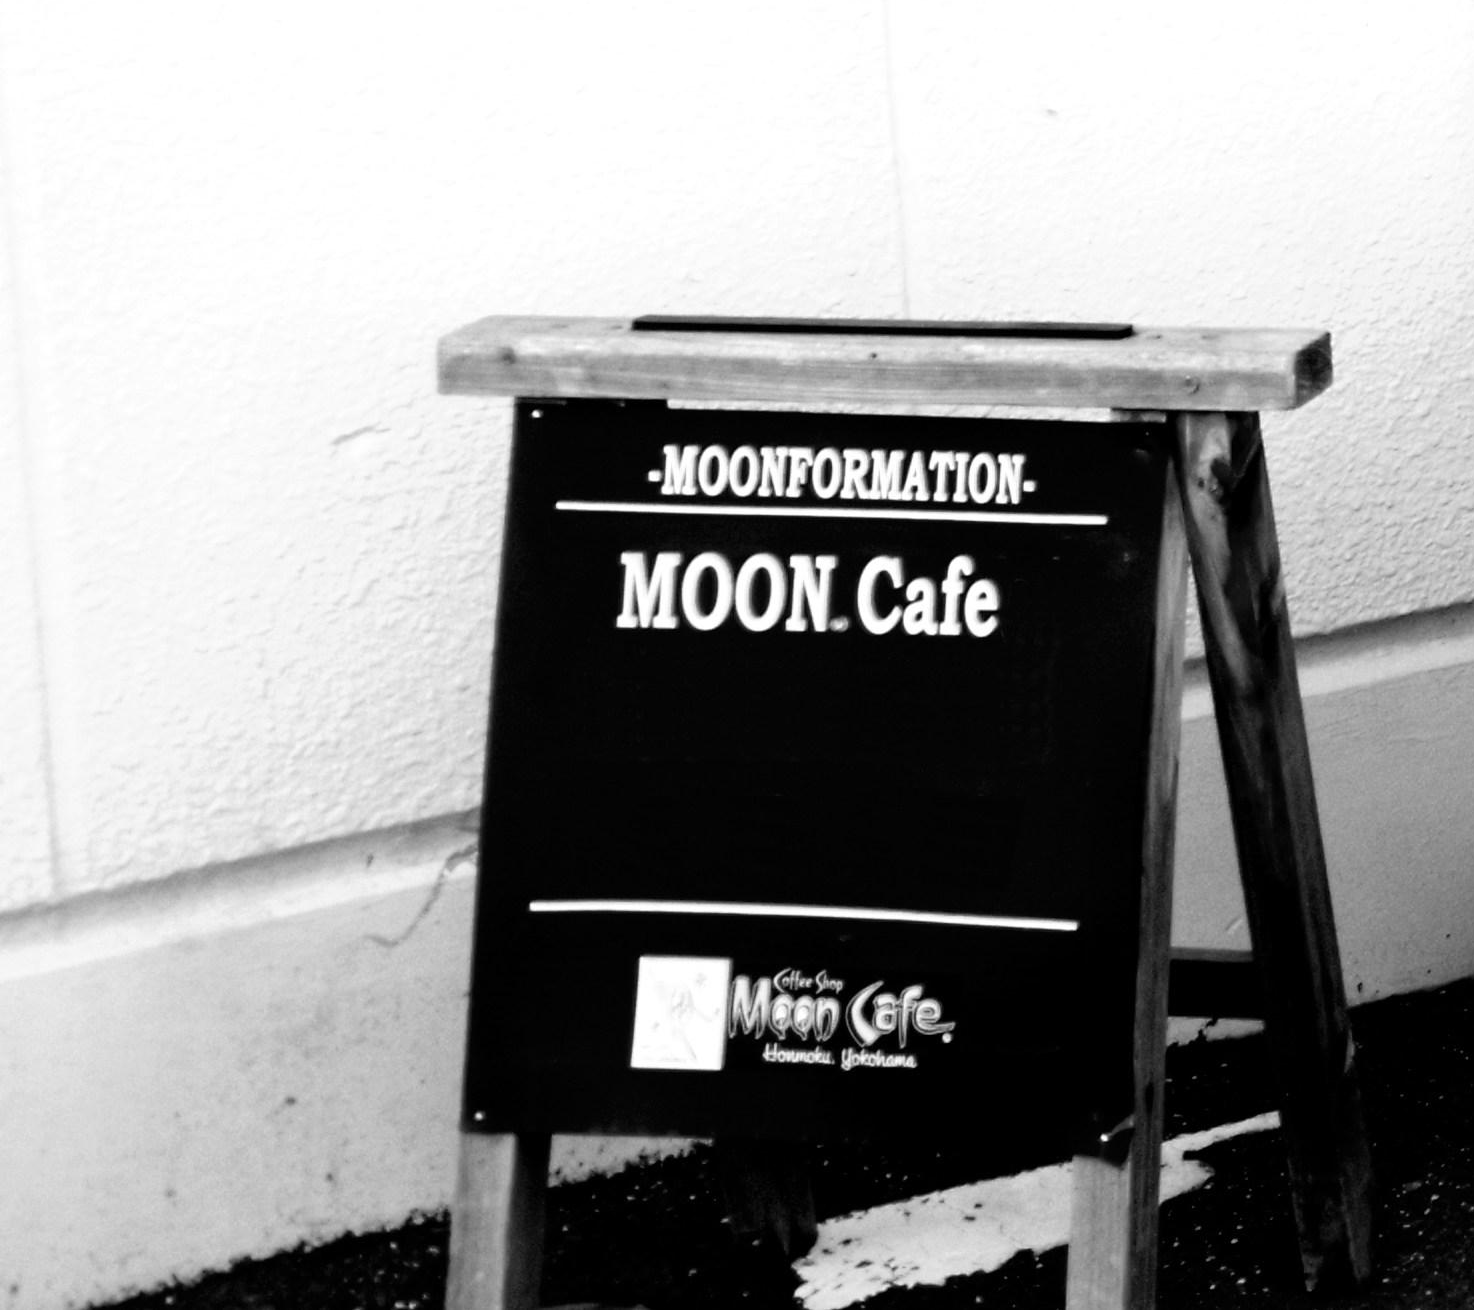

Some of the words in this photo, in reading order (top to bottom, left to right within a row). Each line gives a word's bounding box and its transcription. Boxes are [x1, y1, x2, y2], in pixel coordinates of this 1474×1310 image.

[616, 549, 836, 633] MOON
[857, 555, 1000, 637] Cafe
[773, 967, 812, 993] Coffee
[816, 969, 843, 994] Shop
[727, 975, 841, 1040] Moon
[841, 1047, 918, 1071] Yokohama
